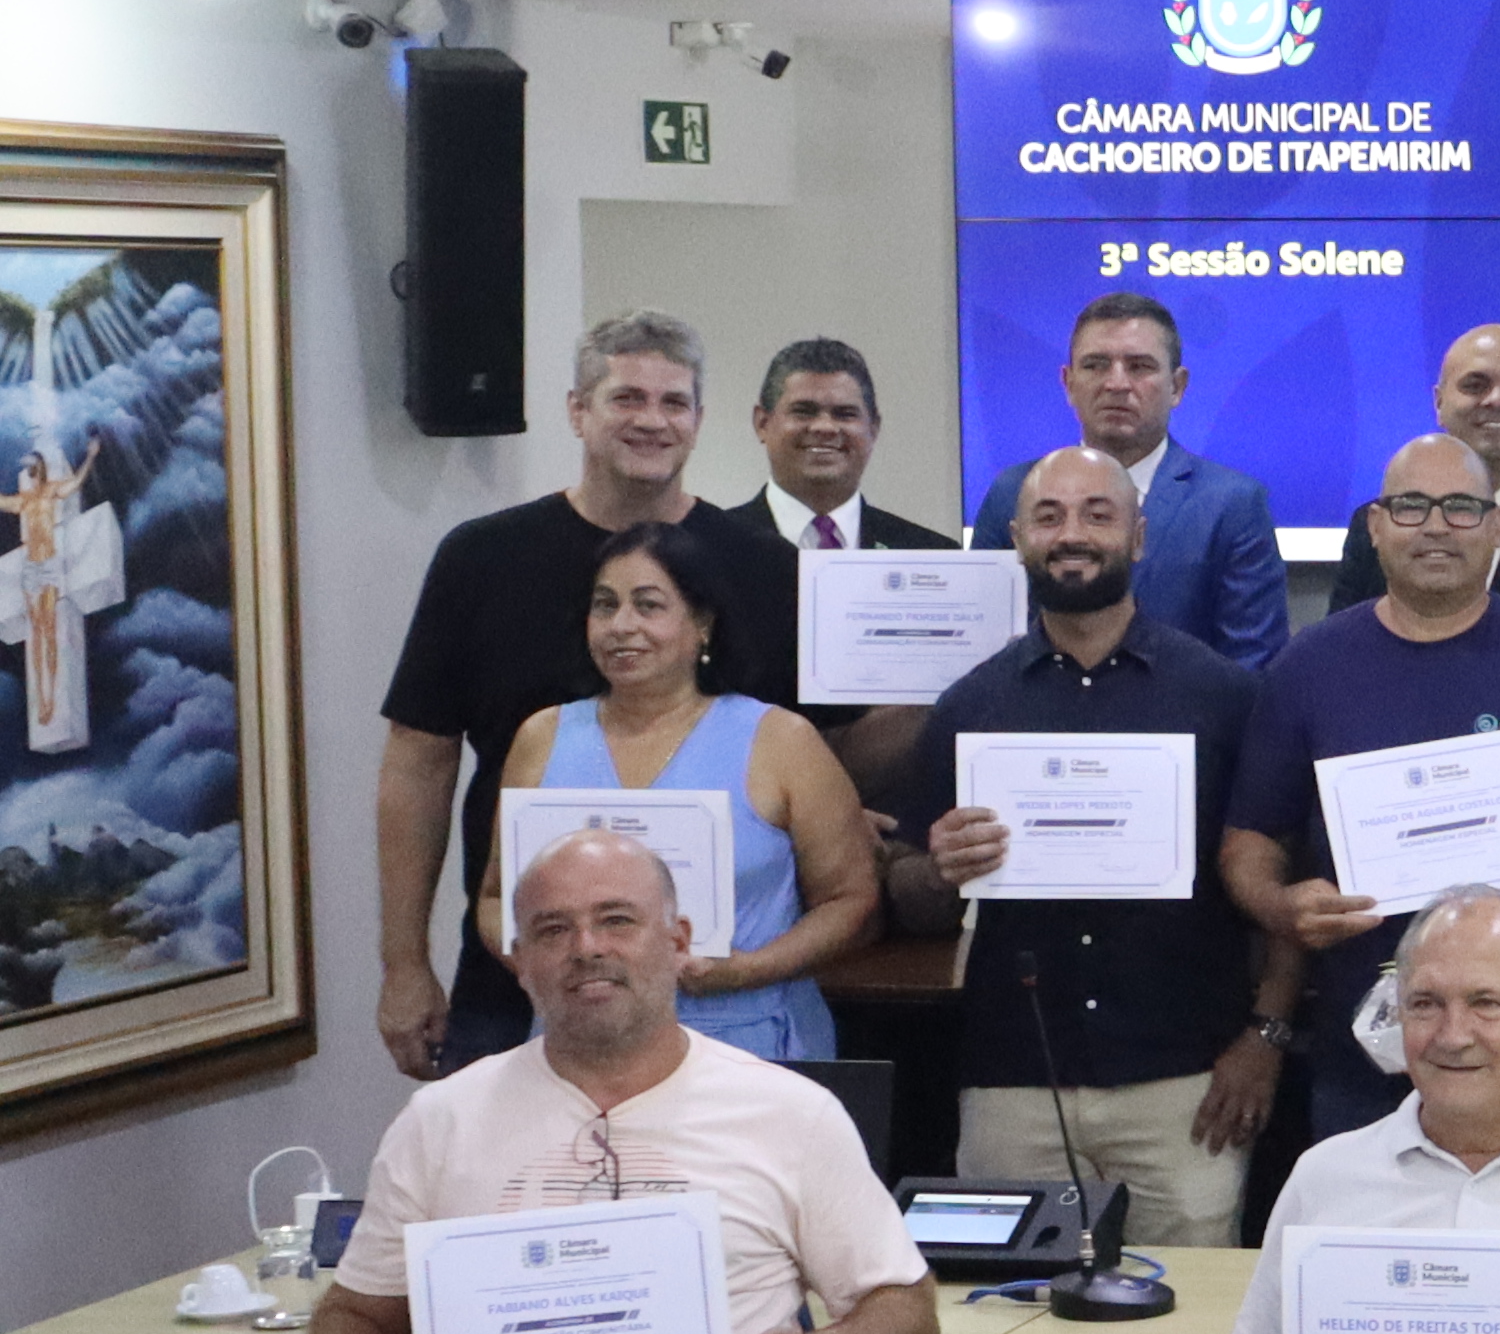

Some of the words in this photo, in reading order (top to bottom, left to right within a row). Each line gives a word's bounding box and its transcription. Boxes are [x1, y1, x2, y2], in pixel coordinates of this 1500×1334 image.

[1057, 97, 1195, 134] CÂMARA
[1201, 101, 1380, 134] MUNICIPAL
[1387, 101, 1432, 133] DE
[1019, 141, 1222, 174] CACHOEIRO
[1227, 141, 1274, 173] DE
[1279, 140, 1471, 172] ITAPEMIRIM
[1099, 242, 1139, 277] 3ª
[1147, 241, 1271, 277] Sessão
[1279, 241, 1405, 277] Solene
[1422, 1273, 1469, 1283] Municipal
[1423, 1263, 1459, 1272] Câmara
[1319, 1319, 1379, 1331] HELENO
[1384, 1320, 1403, 1332] DE
[1408, 1321, 1468, 1334] FREITAS
